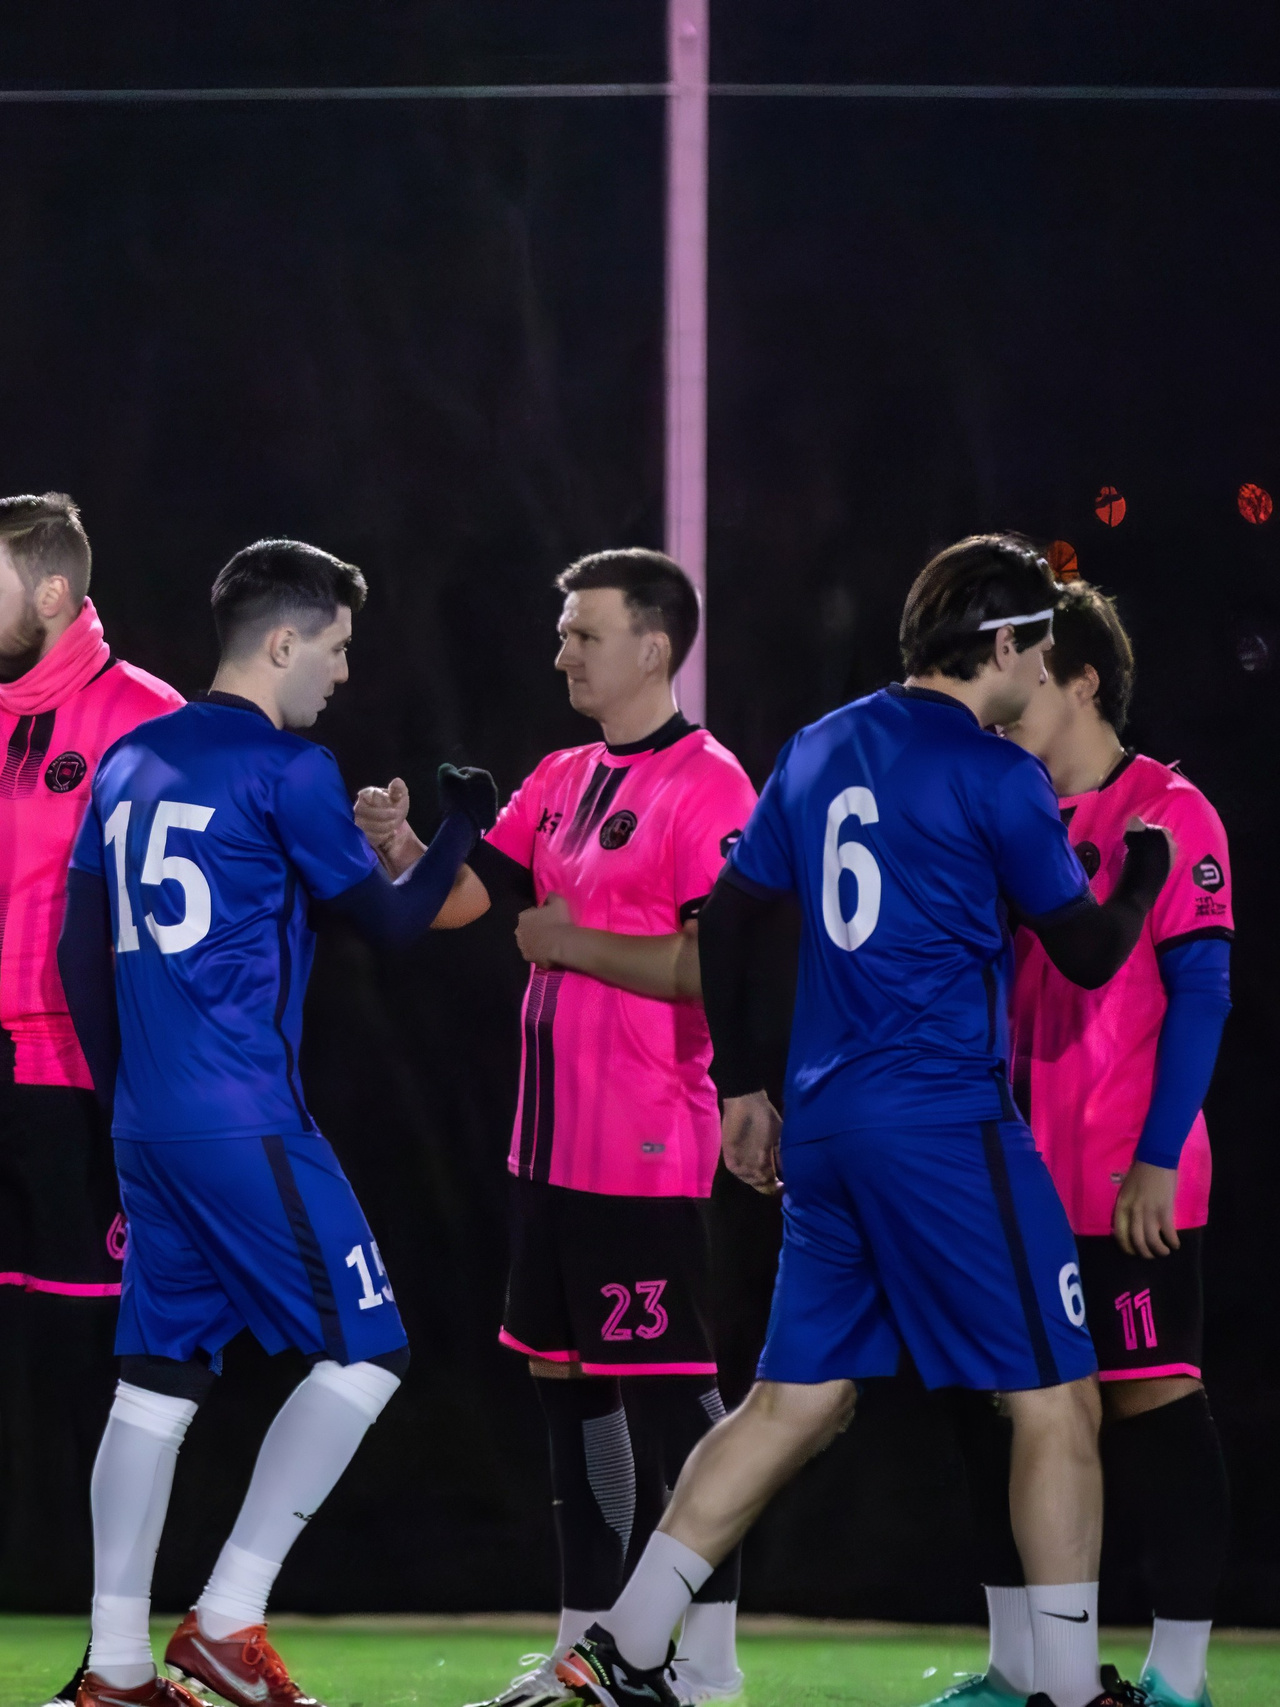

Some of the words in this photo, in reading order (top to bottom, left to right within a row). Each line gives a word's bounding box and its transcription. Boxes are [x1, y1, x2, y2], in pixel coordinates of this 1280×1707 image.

[105, 801, 215, 954] 15
[823, 786, 881, 952] 6
[601, 1280, 668, 1340] 23
[1059, 1262, 1085, 1327] 6
[1115, 1288, 1157, 1350] 11
